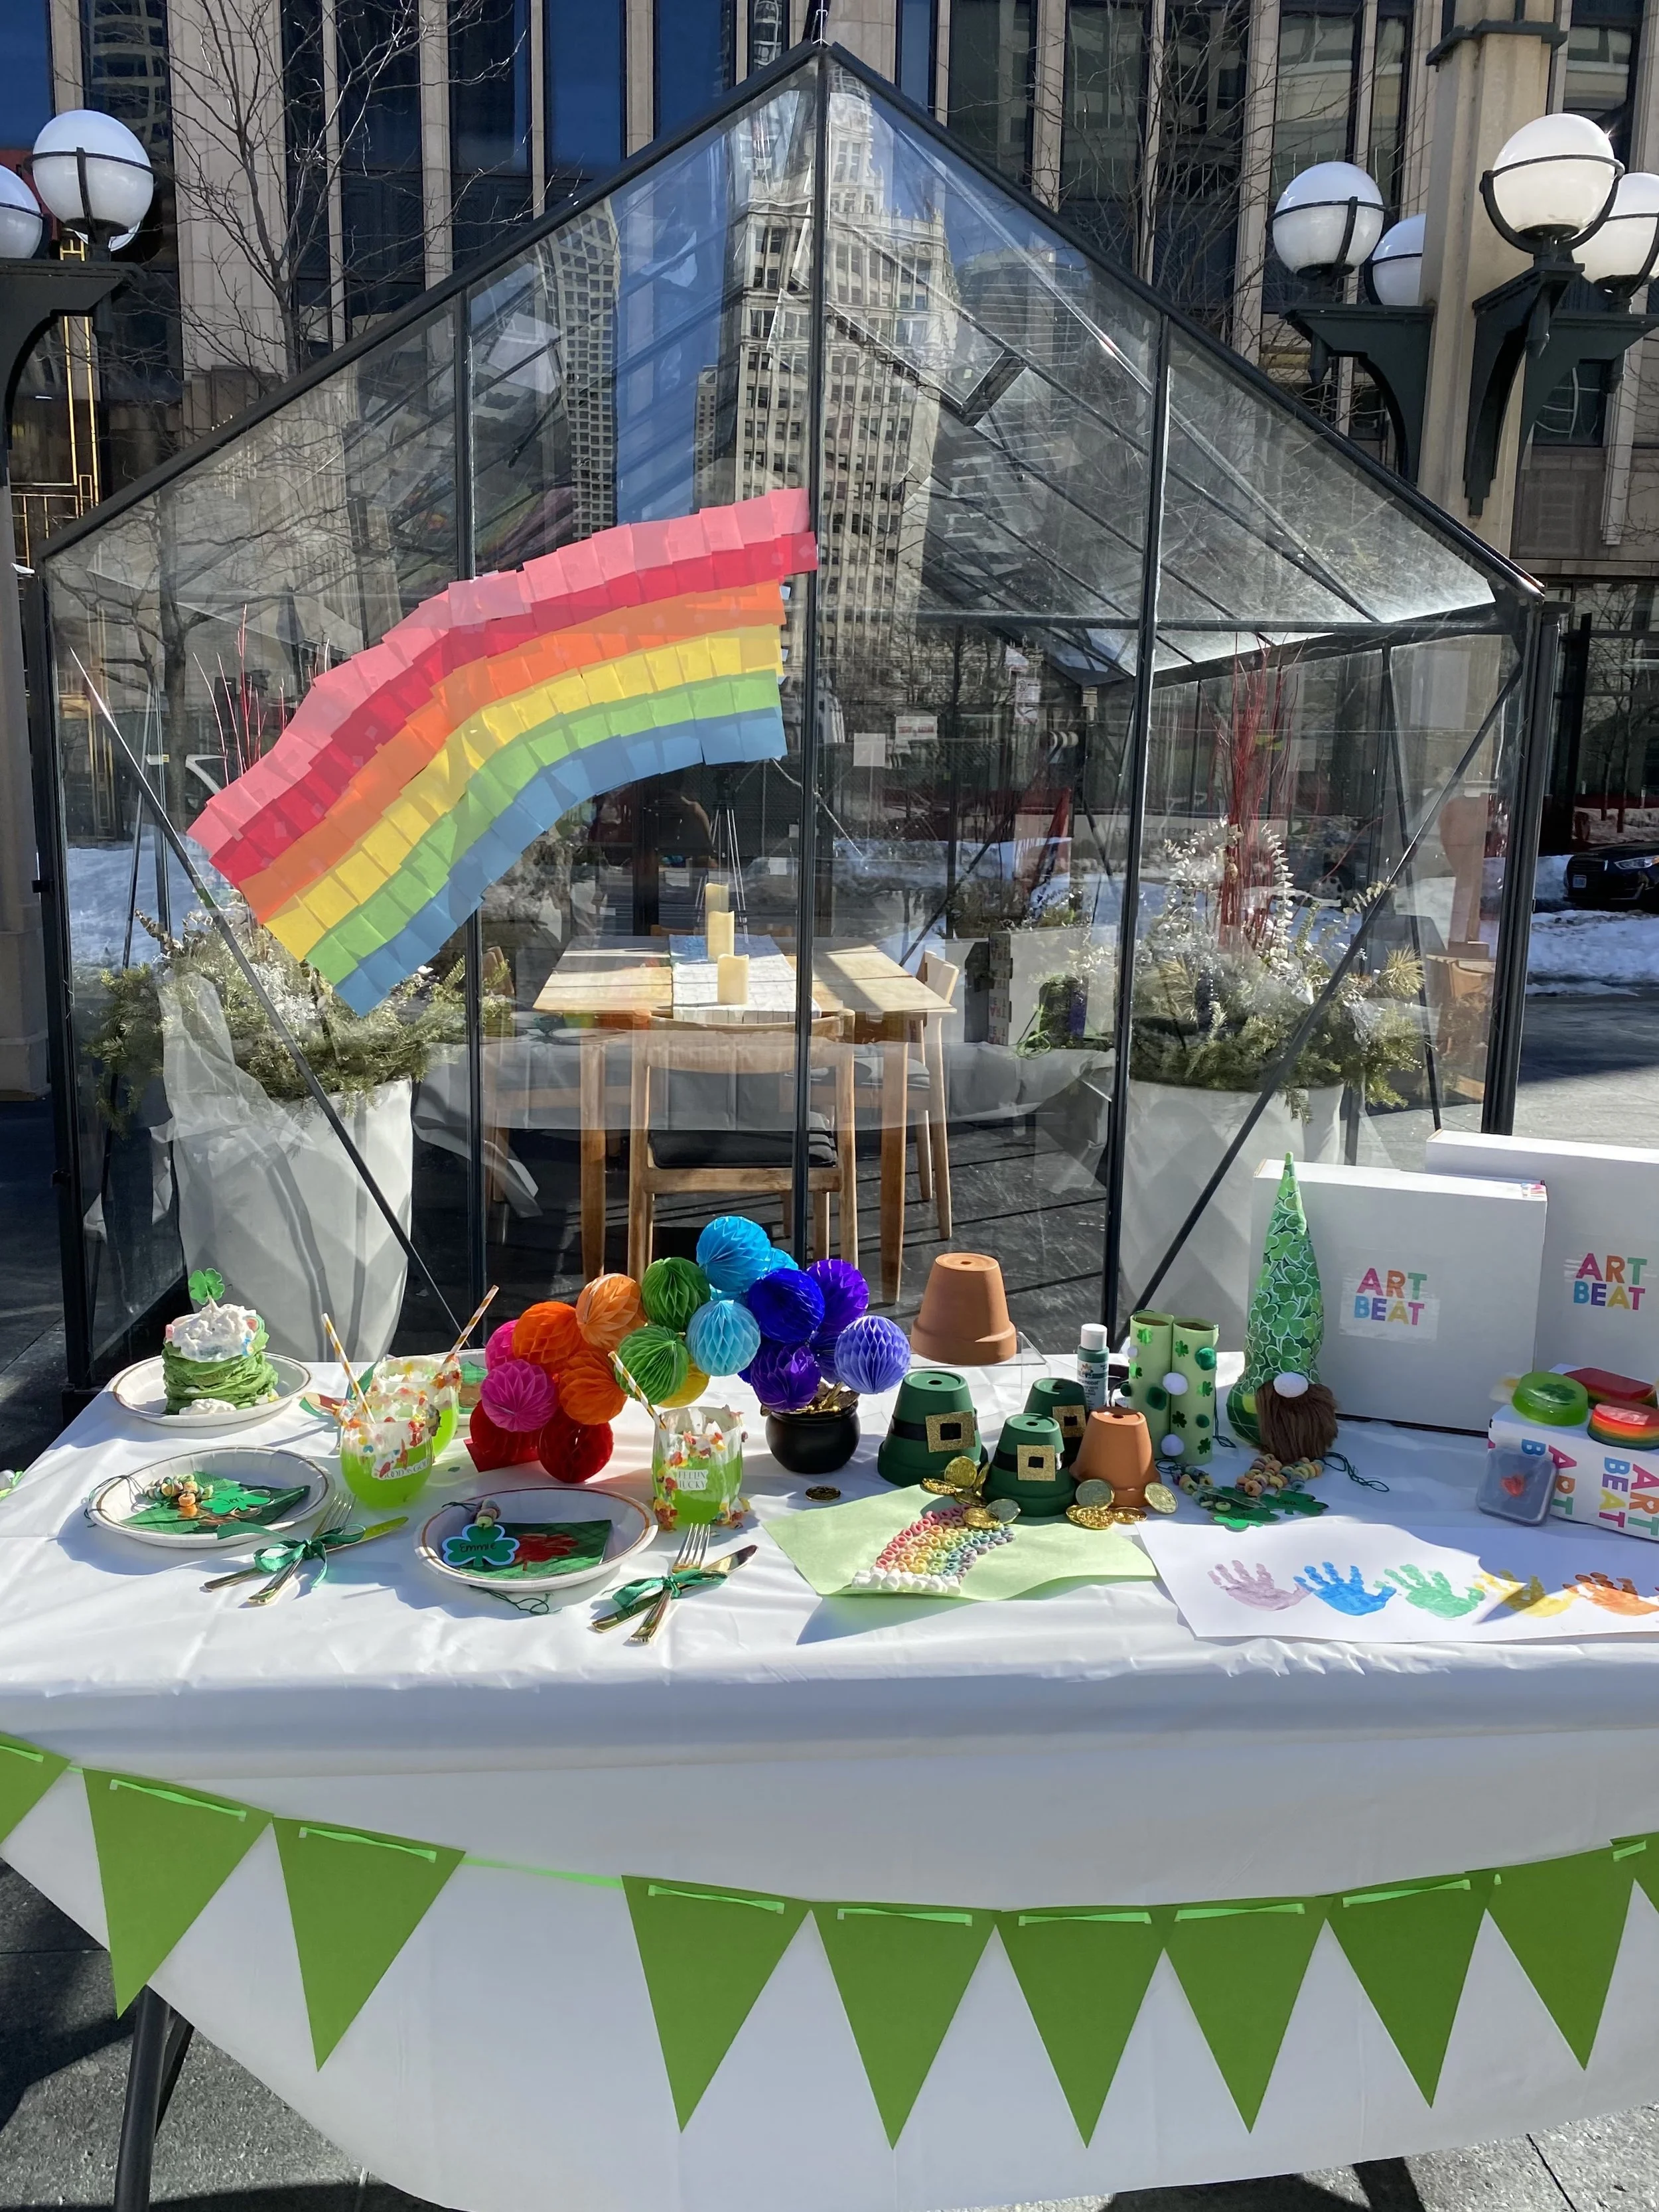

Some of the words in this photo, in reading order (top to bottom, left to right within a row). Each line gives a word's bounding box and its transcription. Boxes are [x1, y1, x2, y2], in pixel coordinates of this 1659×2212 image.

[1356, 1268, 1427, 1300] ART
[1575, 1253, 1647, 1286] ART
[1354, 1295, 1425, 1325] BEAT
[1573, 1281, 1646, 1311] BEAT
[1599, 1457, 1630, 1528] BEAT
[1628, 1463, 1659, 1536] ART
[459, 1542, 497, 1552] Emmie
